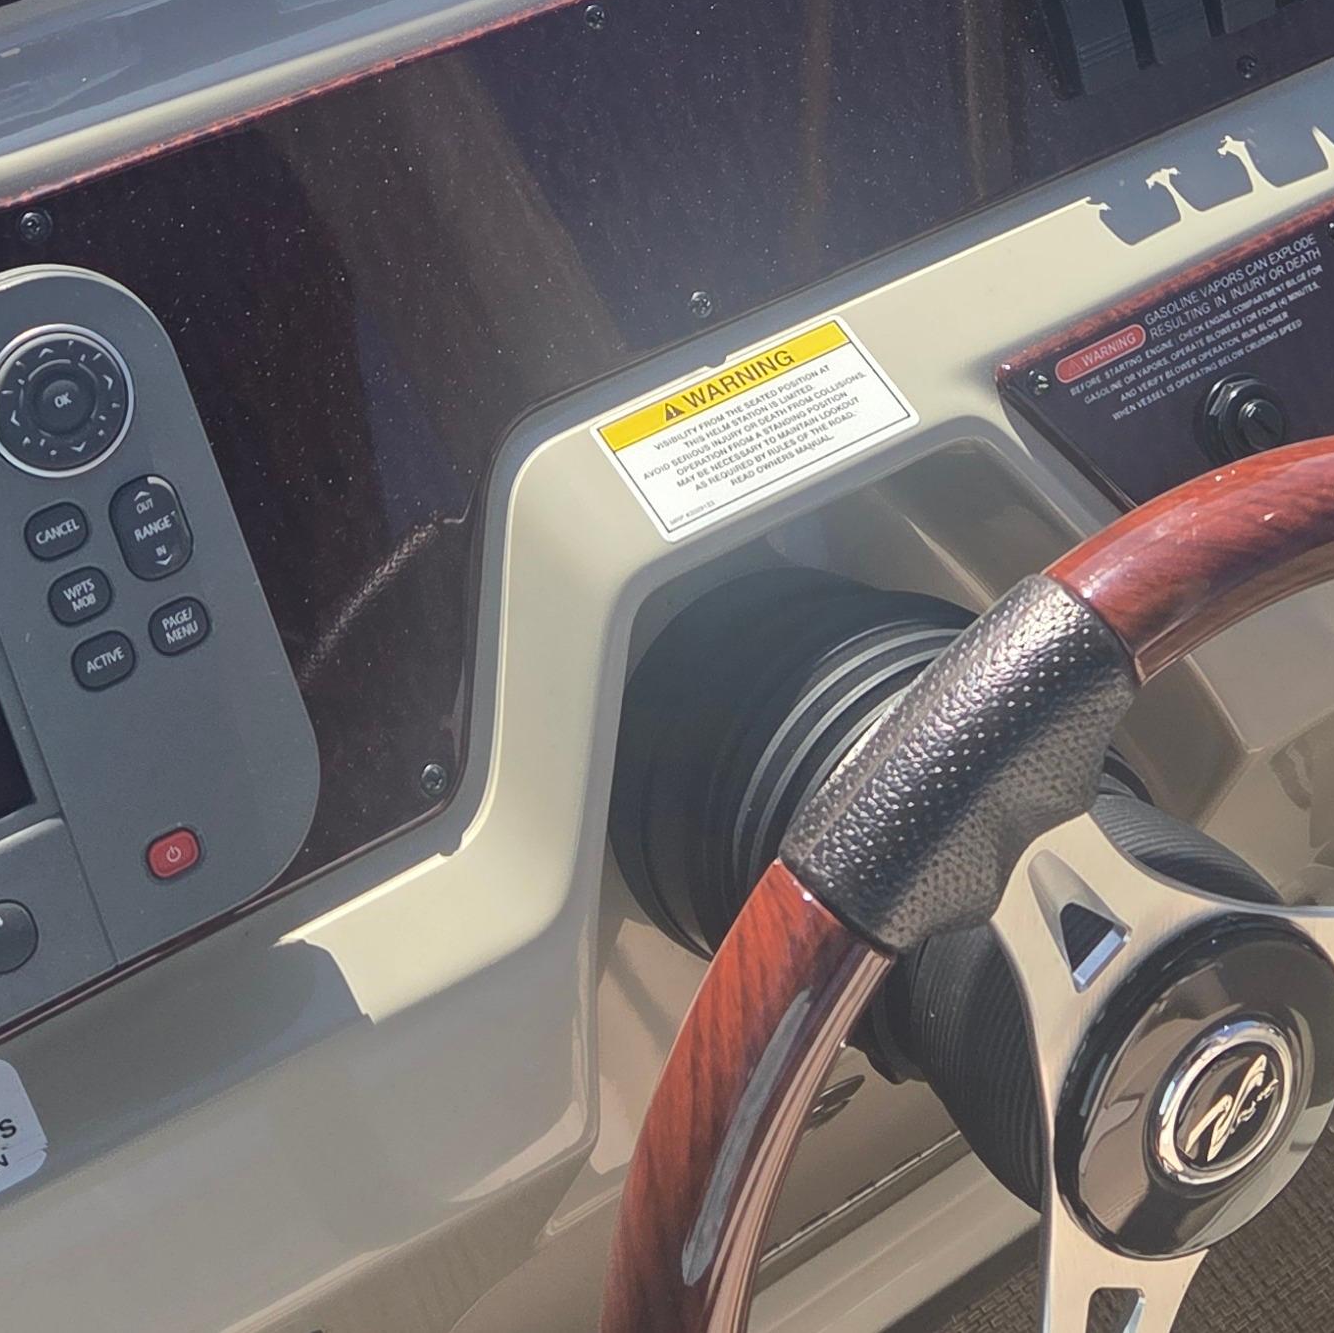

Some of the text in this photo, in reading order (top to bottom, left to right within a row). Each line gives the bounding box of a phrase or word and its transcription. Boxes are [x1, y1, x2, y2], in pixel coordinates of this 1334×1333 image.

[1145, 233, 1316, 325] GASOLINE VAPORS CAN EXPLODE
[1149, 247, 1321, 339] RESULTING IN INJURY OR DEATH
[1081, 333, 1136, 366] WARNING
[682, 351, 794, 407] WARNING
[54, 391, 73, 409] OK
[654, 364, 830, 450] VISIBILITY FROM THE SEATED POSITION AT
[136, 498, 154, 514] OUT
[35, 518, 80, 545] CANCEL
[133, 514, 172, 542] RANGE
[155, 544, 167, 556] IN
[63, 577, 95, 601] WPTS
[71, 593, 96, 612] MOB
[162, 606, 193, 631] PAGE/
[165, 621, 199, 644] MENU
[86, 646, 126, 674] ACTIVE
